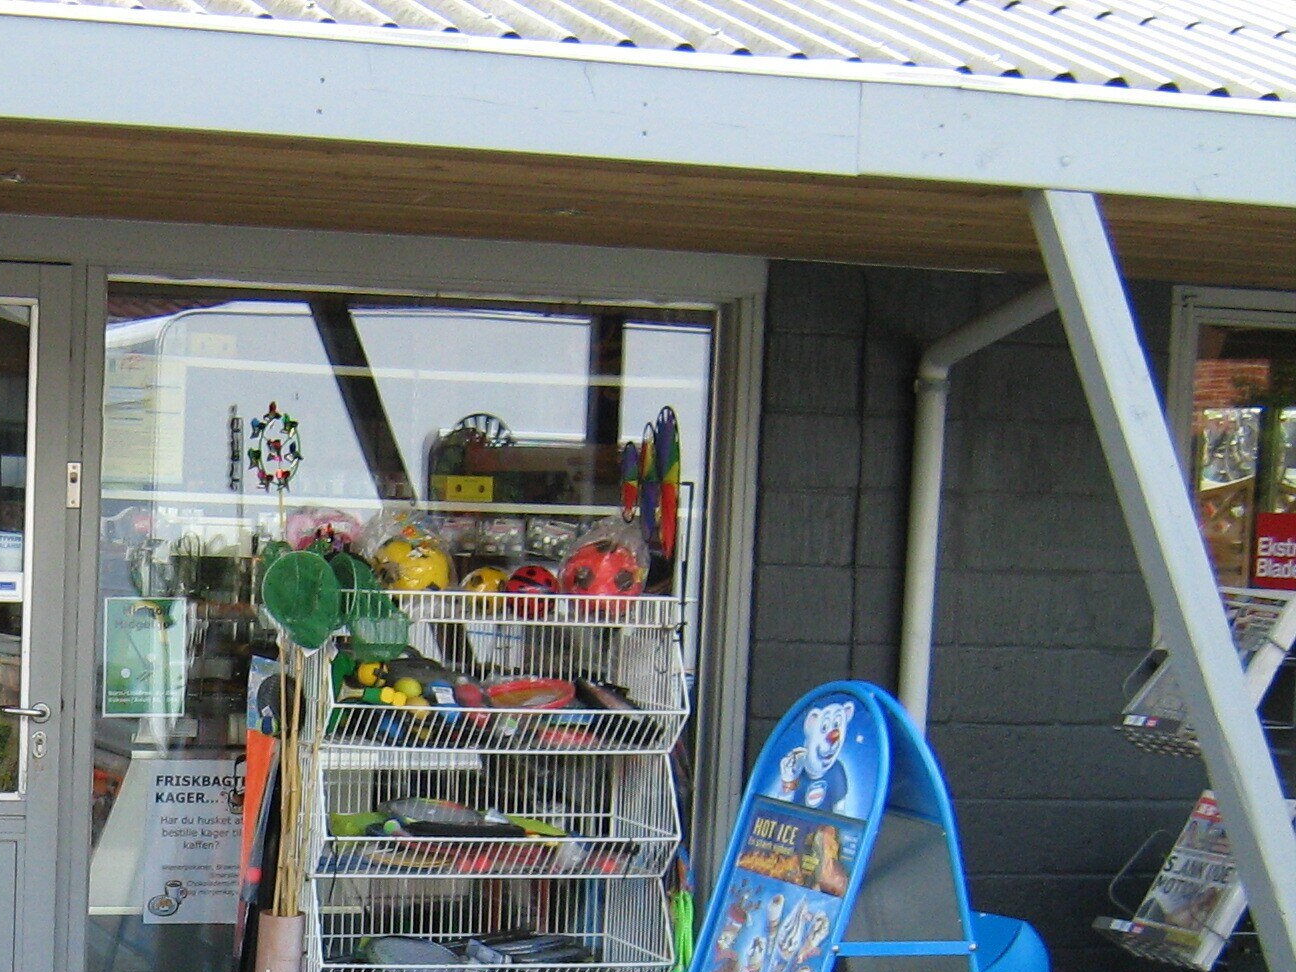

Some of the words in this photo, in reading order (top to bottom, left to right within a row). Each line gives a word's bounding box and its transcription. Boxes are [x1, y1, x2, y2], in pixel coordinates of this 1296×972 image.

[160, 815, 179, 825] Har
[181, 815, 195, 825] du
[197, 815, 232, 825] husket
[201, 828, 230, 839] kager
[752, 817, 777, 839] HOT
[777, 823, 799, 846] ICE
[183, 840, 220, 850] kaffen?
